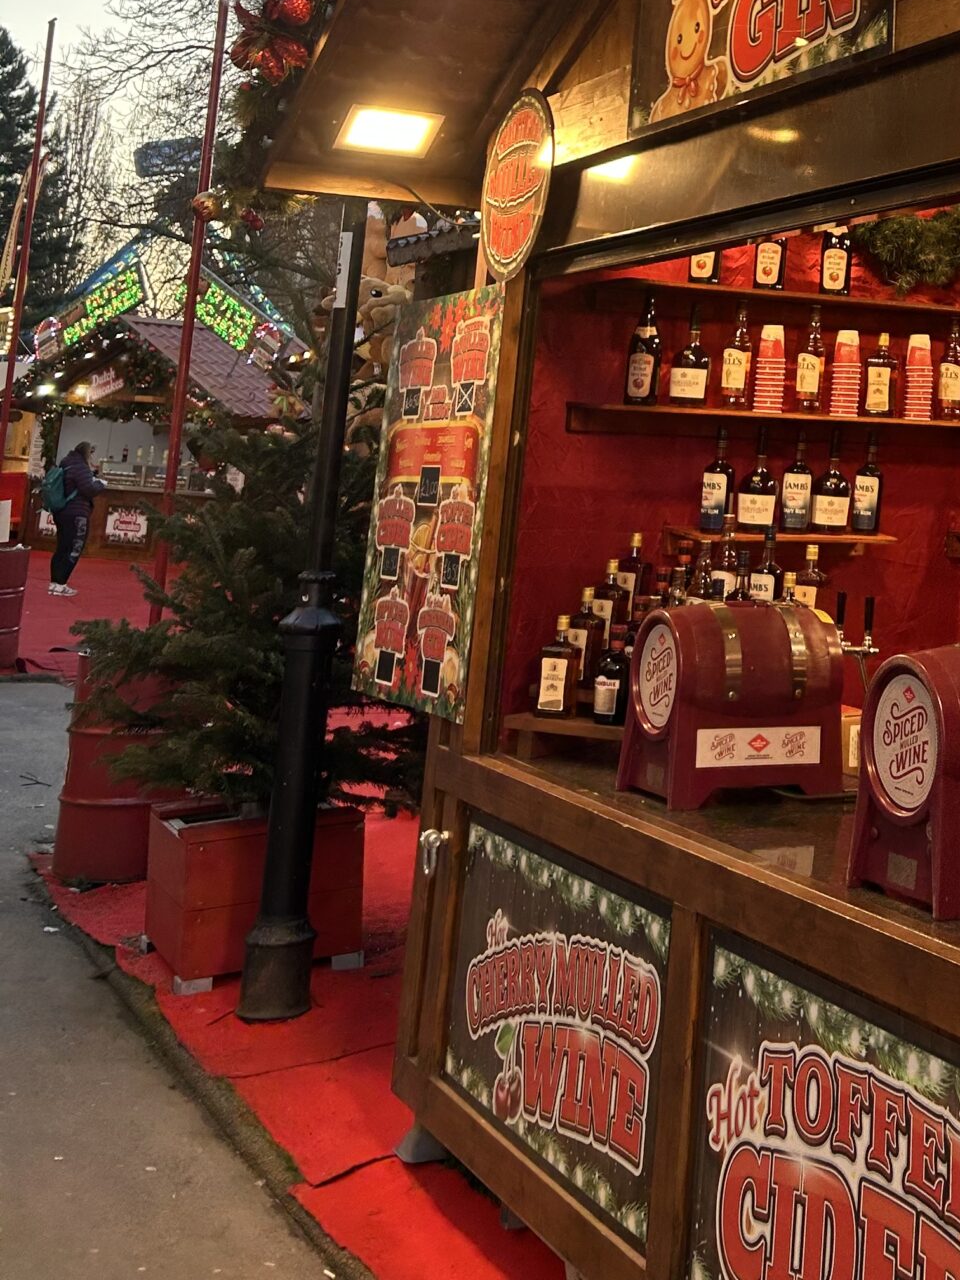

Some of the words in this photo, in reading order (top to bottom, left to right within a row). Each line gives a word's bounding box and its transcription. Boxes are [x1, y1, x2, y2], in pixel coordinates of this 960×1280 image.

[703, 481, 721, 490] AMB'S
[855, 484, 874, 493] AMB'S
[750, 583, 769, 593] AMB'S
[646, 650, 672, 681] SPICED
[651, 673, 673, 701] WINE
[883, 711, 926, 746] SPICED
[717, 742, 736, 757] WINE
[788, 740, 806, 756] WINE
[894, 741, 929, 773] WINE
[468, 940, 554, 1036] CHERRY
[553, 937, 660, 1056] MULLED
[521, 1021, 647, 1171] WINE
[708, 1062, 760, 1150] Hot
